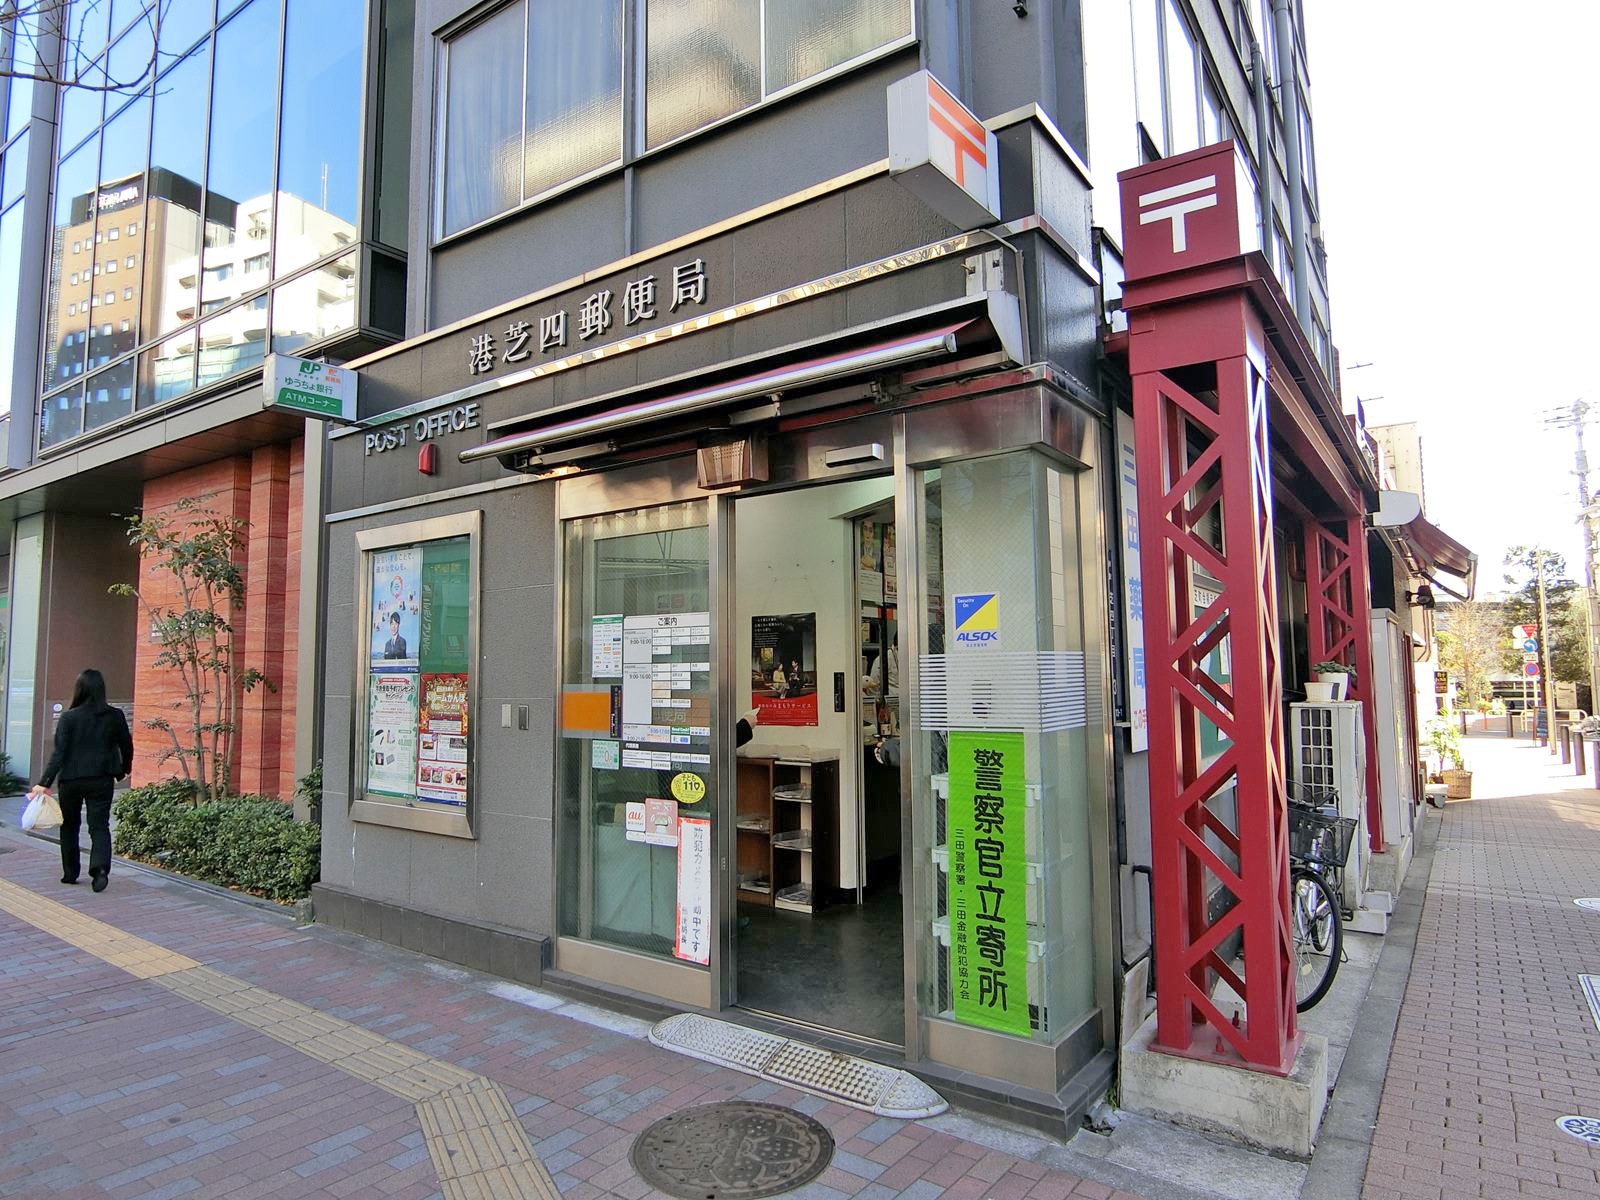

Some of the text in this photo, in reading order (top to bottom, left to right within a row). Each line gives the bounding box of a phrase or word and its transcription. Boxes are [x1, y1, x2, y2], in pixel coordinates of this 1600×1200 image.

[468, 257, 708, 376] 港芝四郵便局
[284, 376, 334, 395] ゆうちょ銀行
[285, 392, 337, 408] ATMコーナー
[365, 403, 481, 456] POST OFFICE
[657, 617, 678, 627] ご案内
[956, 631, 998, 642] ALSOK
[628, 810, 643, 820] au
[973, 748, 1008, 1012] 警察官立寄所
